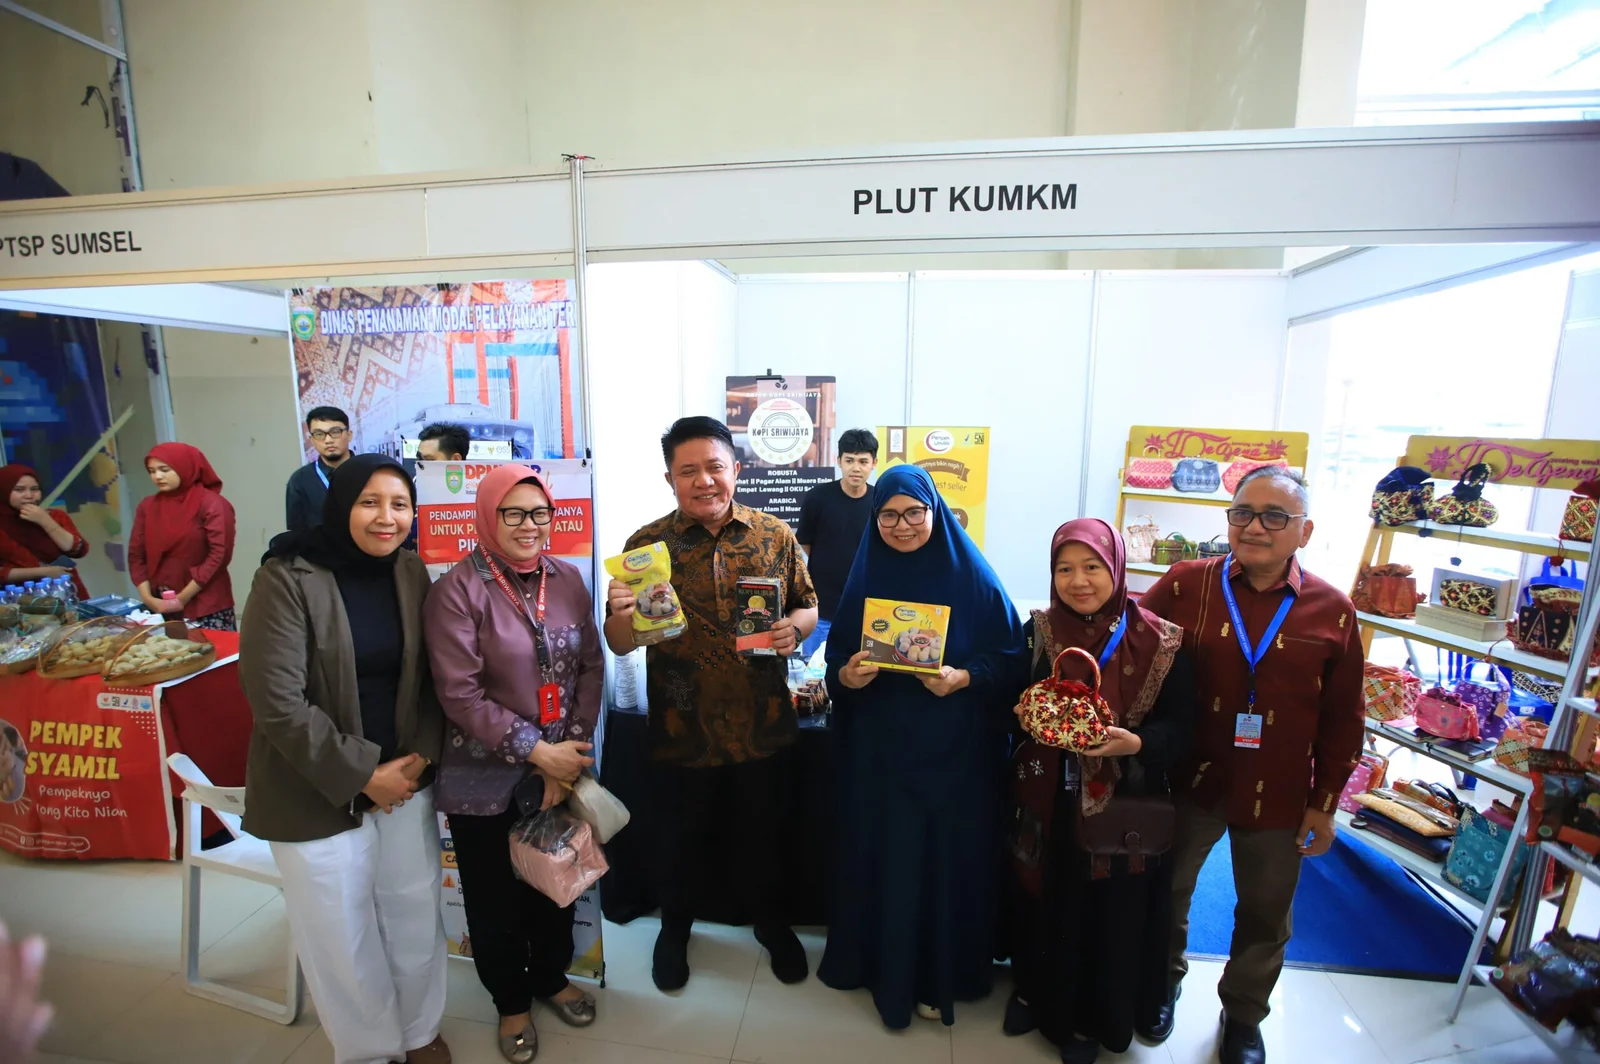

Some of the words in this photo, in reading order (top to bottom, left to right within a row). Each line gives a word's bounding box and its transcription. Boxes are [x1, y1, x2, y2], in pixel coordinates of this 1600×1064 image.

[854, 187, 938, 214] PLUT
[949, 184, 1078, 212] KUMKM
[52, 230, 142, 256] SUMSEL
[320, 307, 355, 335] DINAS
[358, 304, 428, 334] PENANAMAN
[432, 305, 474, 332] MODAL
[476, 301, 548, 332] PELAYANAN
[771, 428, 809, 436] SRIWIJAYA
[948, 482, 967, 491] seller
[430, 524, 464, 535] UNTUK
[554, 518, 583, 532] ATAU
[490, 563, 500, 576] KOPI
[498, 573, 520, 606] SRIWIJAYA
[1232, 606, 1240, 624] BUSINESS
[1237, 624, 1246, 643] CONCEPT
[30, 720, 122, 749] PEMPEK
[24, 752, 120, 780] SYAMIL
[39, 785, 110, 802] Pempeknyo
[64, 805, 89, 818] Kito
[95, 806, 128, 818] Nian
